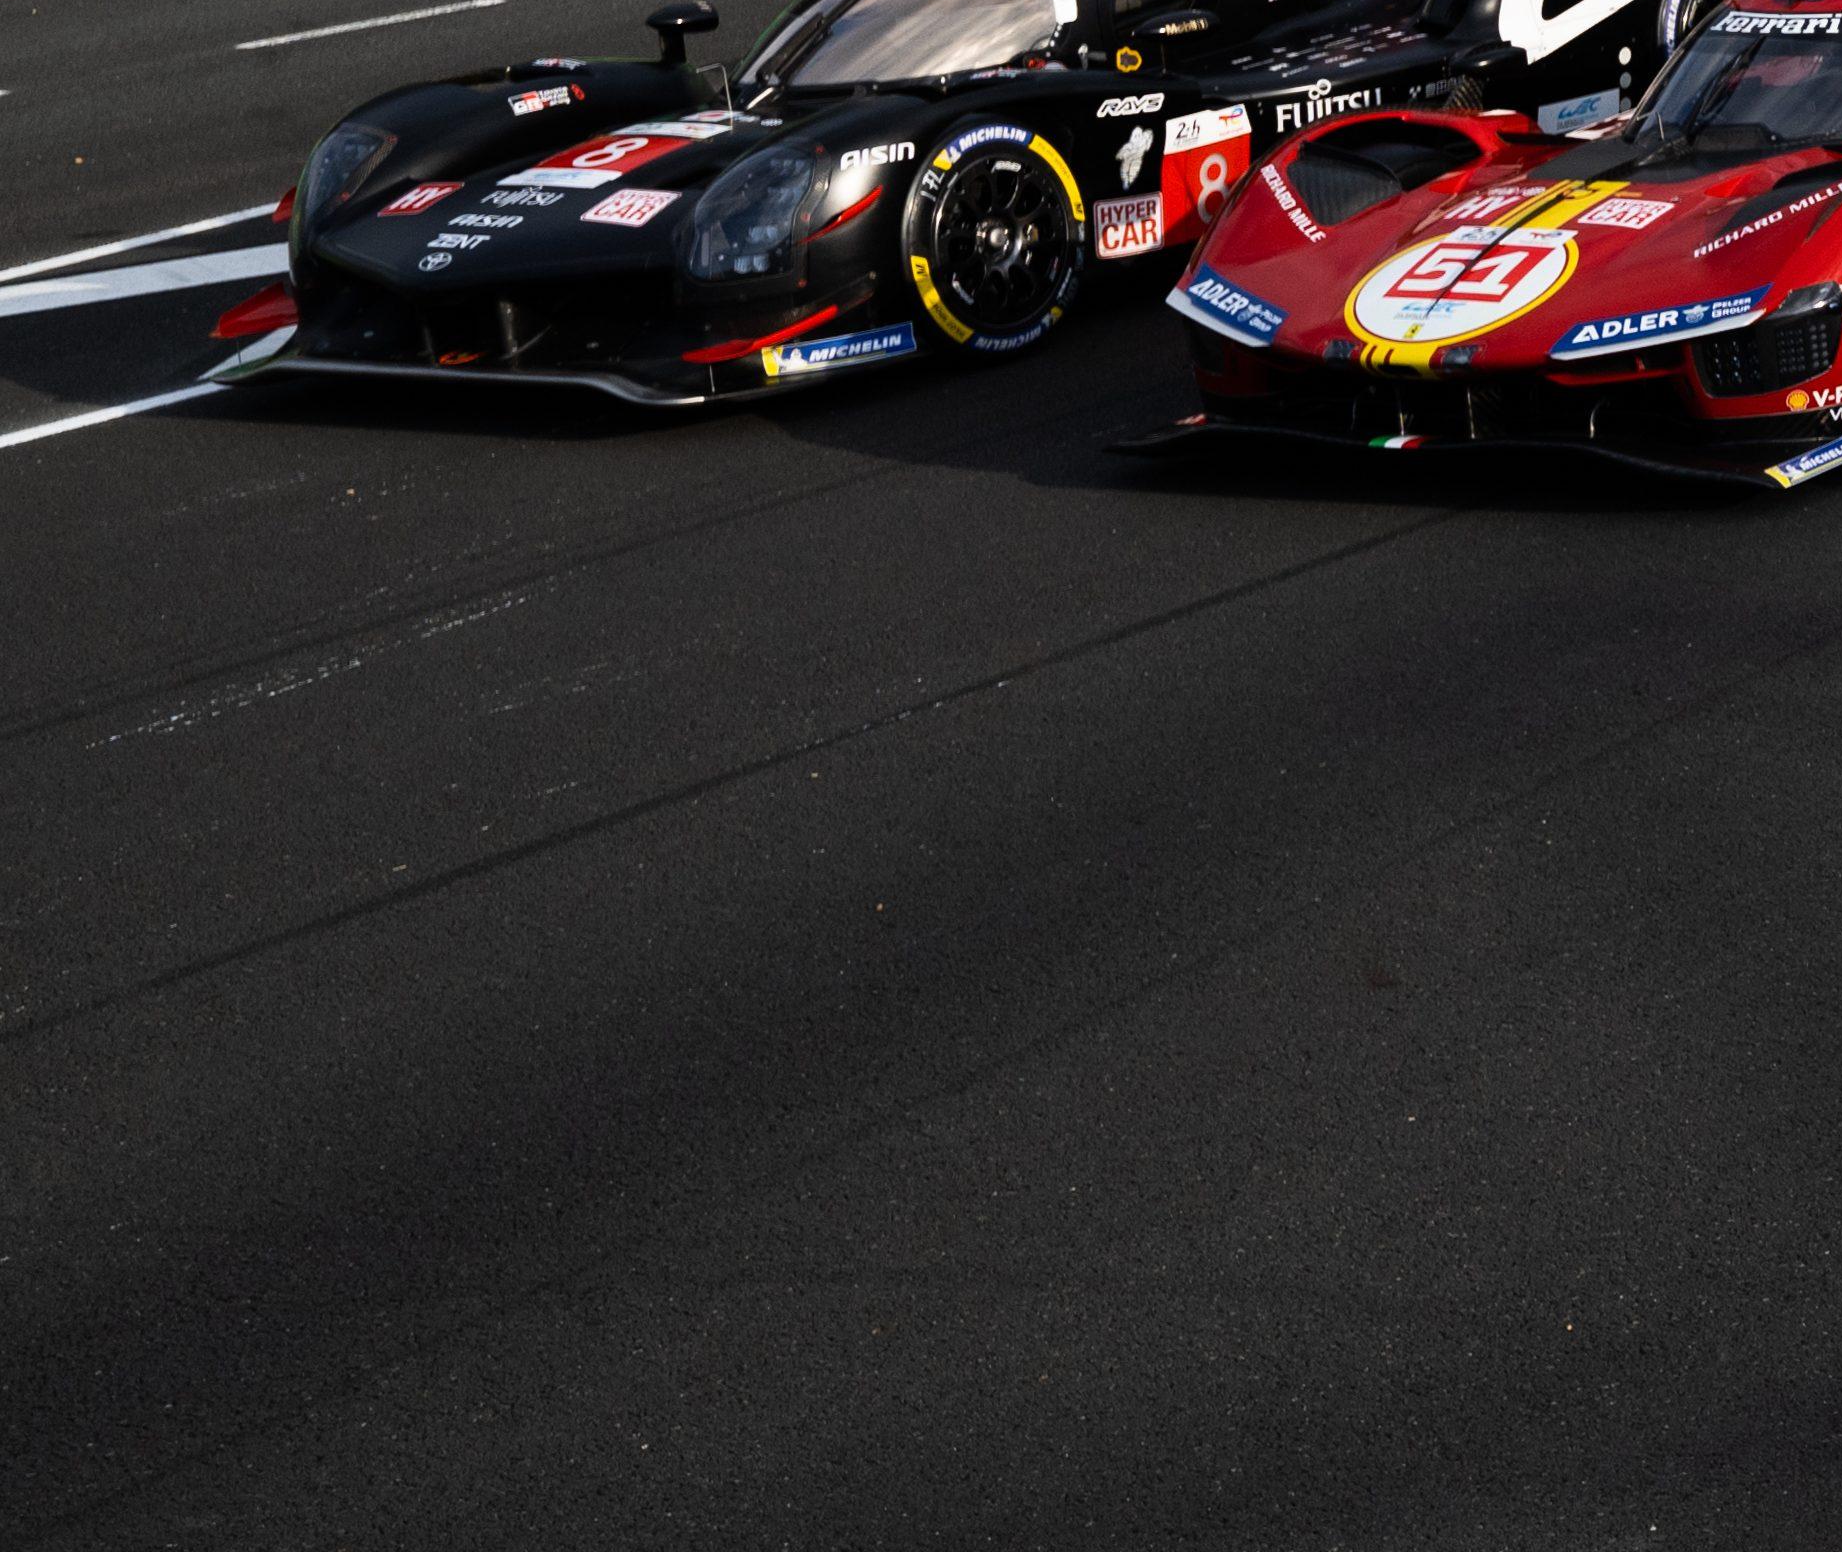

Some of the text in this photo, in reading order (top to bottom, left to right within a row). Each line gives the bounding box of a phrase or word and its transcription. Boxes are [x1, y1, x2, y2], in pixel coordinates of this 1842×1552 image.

[1709, 10, 1842, 36] Ferrari
[1096, 92, 1165, 118] RAYS
[571, 136, 650, 168] 8
[958, 125, 1028, 152] MICHELIN
[840, 140, 916, 171] AISIN
[387, 186, 453, 210] HY
[481, 186, 564, 208] FUJITSU
[1197, 152, 1231, 225] 8
[592, 198, 655, 221] CAR
[1100, 200, 1158, 225] HYPER
[1260, 163, 1327, 244] RICHARD MILLE
[447, 213, 524, 229] AISIN
[1101, 218, 1160, 250] CAR
[427, 233, 491, 250] ZENT
[1693, 212, 1784, 259] RICHARD
[1395, 248, 1531, 297] 51
[1190, 277, 1244, 318] ADLER
[1712, 296, 1752, 310] PELZER
[1571, 309, 1679, 345] ADLER
[809, 333, 902, 363] MICHELIN
